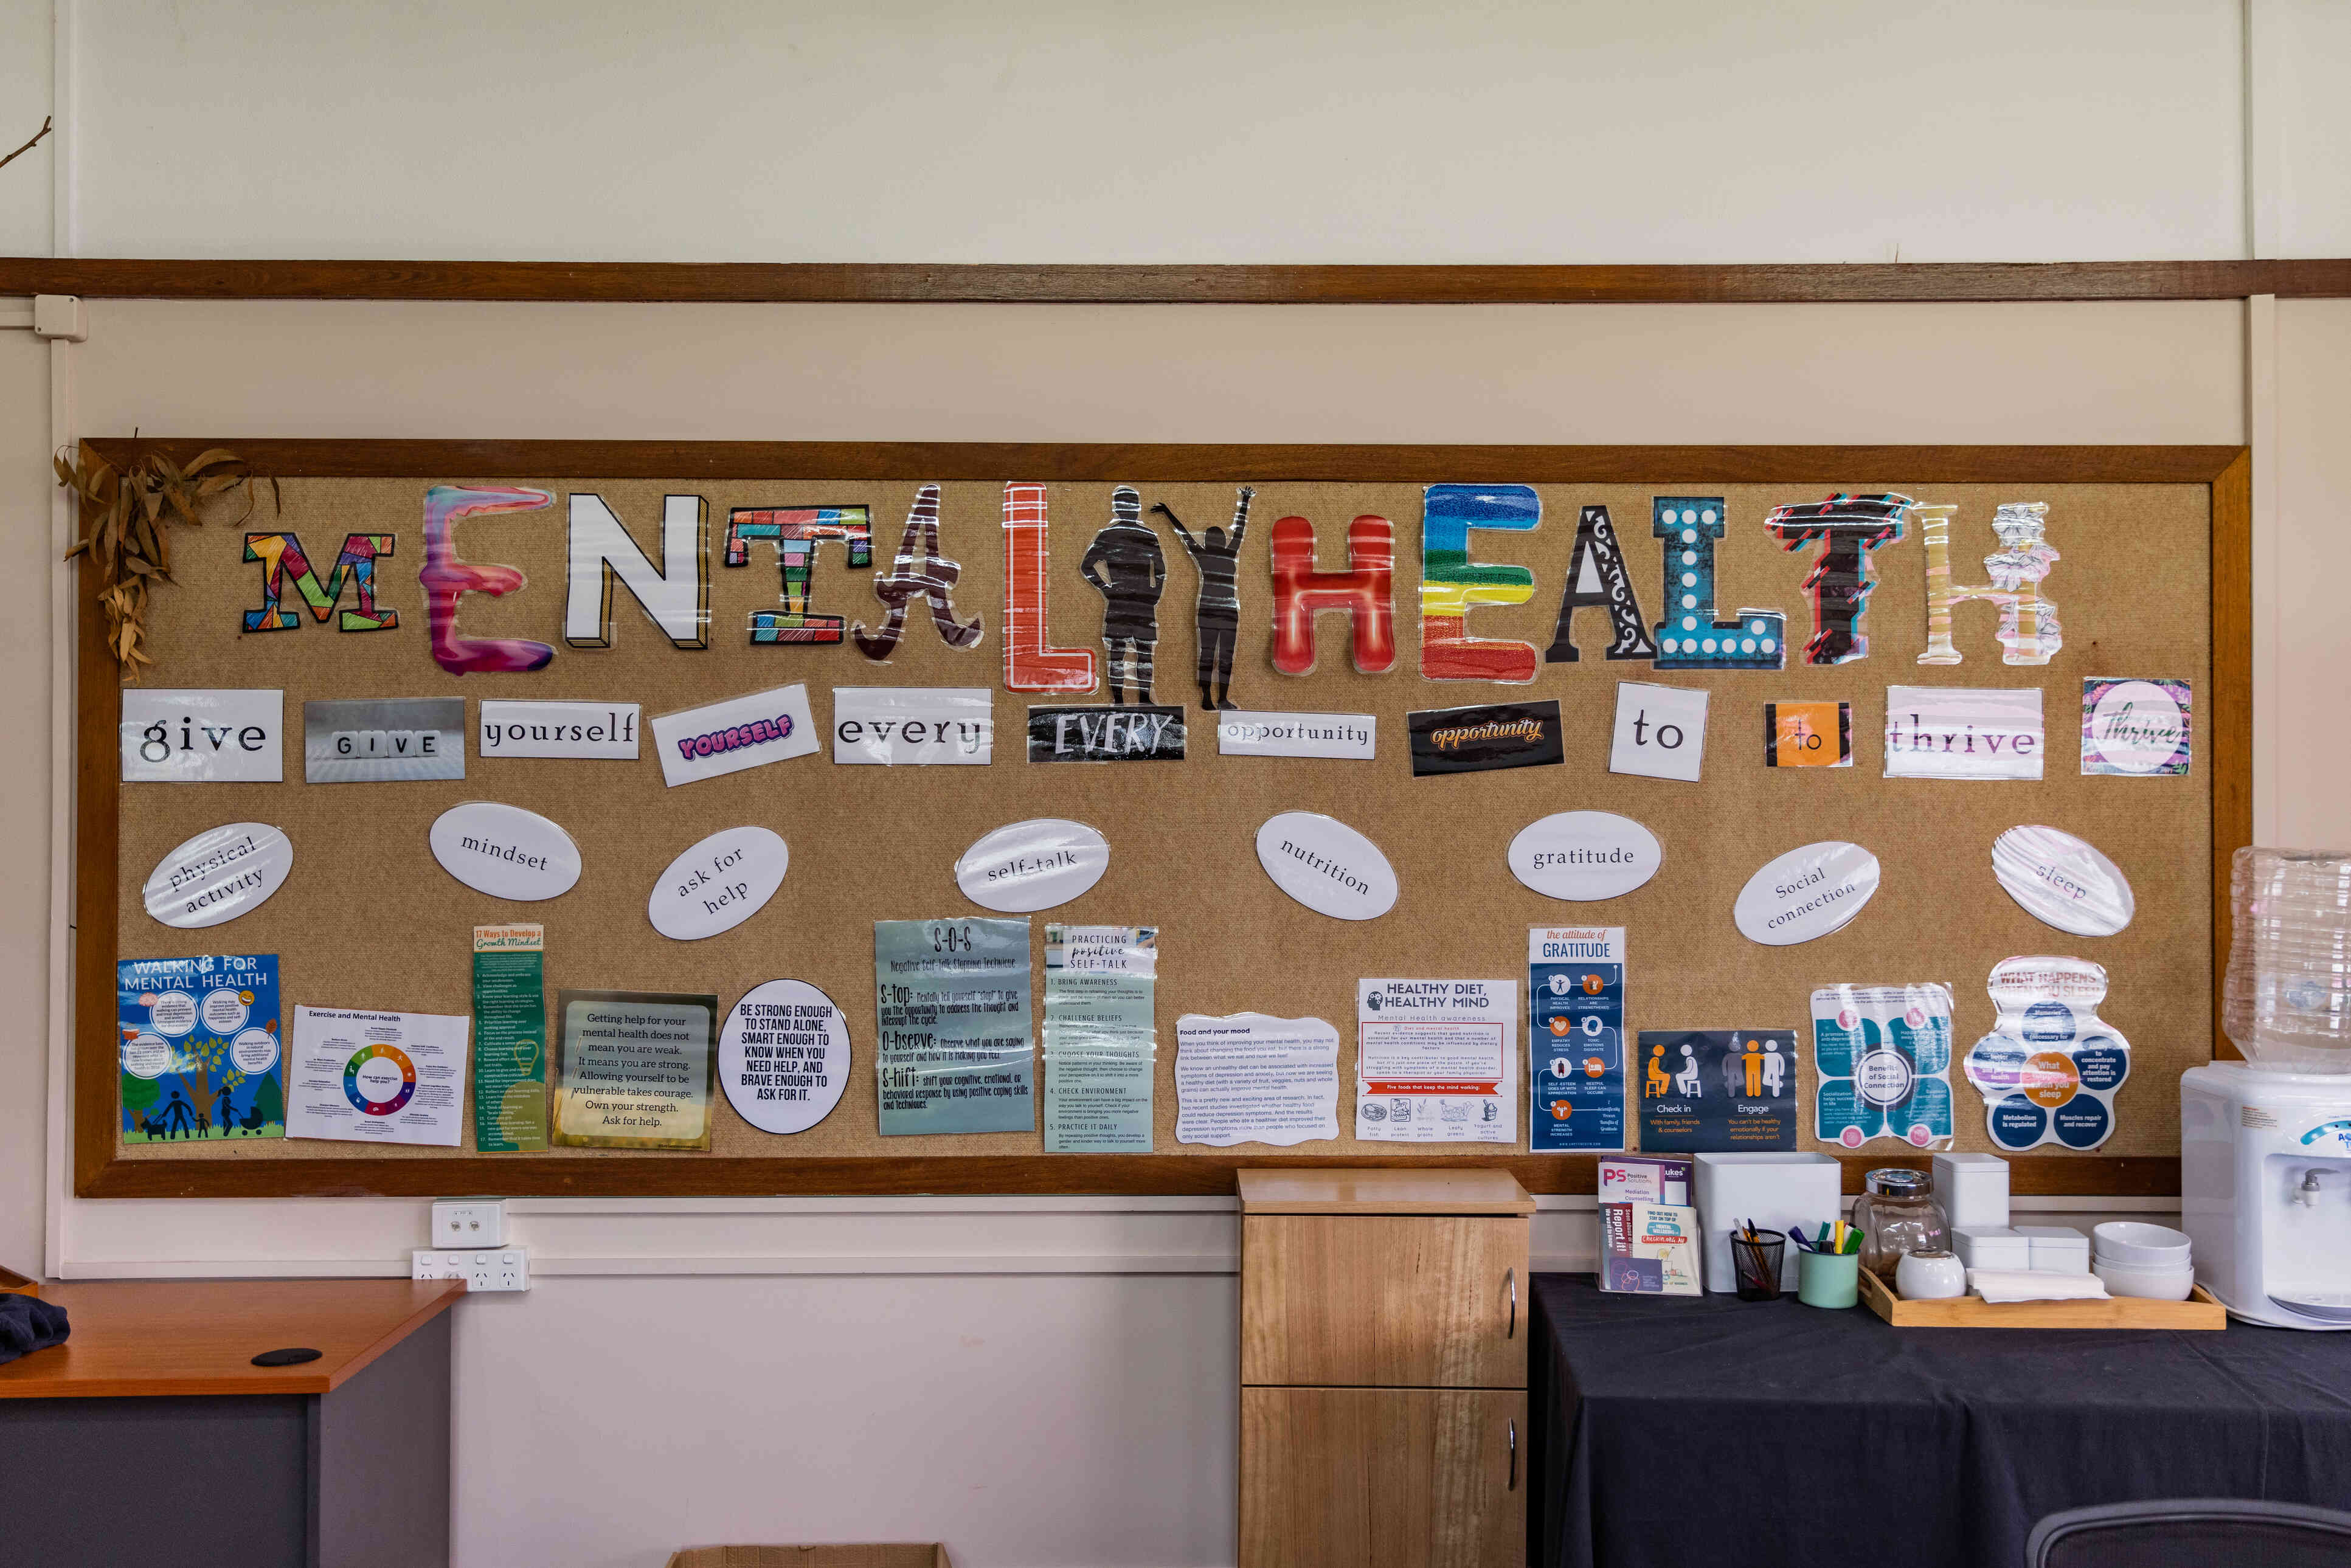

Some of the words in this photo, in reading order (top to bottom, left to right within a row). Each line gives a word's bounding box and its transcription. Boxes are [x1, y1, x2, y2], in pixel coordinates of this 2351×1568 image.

[243, 482, 1098, 692] MENTAL
[485, 713, 634, 746] yourself
[678, 714, 794, 761] YOURSELF
[838, 718, 982, 754] every
[1054, 713, 1174, 755] EVERY
[1227, 721, 1368, 746] opportunity
[1432, 718, 1544, 750] opportunity
[1635, 708, 1683, 749] to
[1795, 718, 1822, 751] to
[1893, 714, 2035, 755] thrive
[139, 717, 266, 763] give
[338, 736, 437, 755] GIVE
[461, 834, 549, 873] mindset
[1532, 848, 1635, 869] gratitude
[169, 835, 258, 893] physical
[676, 869, 712, 900] ask
[715, 846, 746, 876] for
[988, 850, 1077, 882] self-talk
[1280, 839, 1369, 896] nutrition
[185, 866, 266, 914] activity
[1775, 866, 1826, 901] Social
[2035, 864, 2088, 901] sleep
[704, 879, 750, 917] help
[1767, 881, 1856, 931] connection
[477, 938, 505, 949] Growth
[508, 938, 541, 946] Mindset
[483, 930, 500, 939] Ways
[934, 927, 971, 952] S-O-S
[1547, 930, 1559, 939] the
[1562, 930, 1596, 939] attitude
[1598, 929, 1607, 941] of
[1072, 945, 1124, 958] positive
[1543, 943, 1610, 957] GRATITUDE
[134, 958, 214, 974] WALKING
[224, 958, 257, 971] FOR
[125, 976, 193, 990] MENTAL
[203, 973, 266, 987] HEALTH
[1387, 984, 1449, 994] HEALTHY
[1455, 984, 1486, 996] DIET,
[881, 984, 912, 1007] S-top:
[1385, 997, 1447, 1007] HEALTHY
[1453, 997, 1489, 1008] MIND
[587, 1014, 622, 1024] Getting
[625, 1015, 645, 1025] help
[647, 1016, 661, 1024] for
[741, 1004, 752, 1015] BE
[755, 1005, 792, 1017] STRONG
[795, 1006, 832, 1017] ENOUGH
[618, 1029, 648, 1038] health
[745, 1018, 757, 1029] TO
[760, 1019, 790, 1031] STAND
[793, 1020, 826, 1032] ALONE,
[742, 1032, 774, 1044] SMART
[778, 1034, 814, 1045] ENOUGH
[817, 1034, 828, 1045] TO
[617, 1045, 634, 1054] you
[655, 1046, 682, 1054] weak.
[745, 1046, 773, 1058] KNOW
[776, 1047, 803, 1059] WHEN
[807, 1048, 825, 1059] YOU
[622, 1060, 639, 1068] you
[659, 1061, 690, 1071] strong.
[747, 1060, 770, 1072] NEED
[774, 1061, 800, 1074] HELP,
[803, 1062, 822, 1072] AND
[580, 1071, 623, 1082] Allowing
[626, 1073, 665, 1082] yourself
[742, 1074, 772, 1085] BRAVE
[775, 1075, 812, 1086] ENOUGH
[815, 1076, 827, 1087] TO
[883, 1066, 919, 1087] S-hift:
[574, 1086, 625, 1095] vulnerable
[628, 1088, 651, 1096] takes
[654, 1089, 693, 1099] courage.
[757, 1088, 776, 1100] ASK
[779, 1089, 796, 1100] FOR
[799, 1090, 810, 1100] IT.
[586, 1100, 609, 1109] Own
[612, 1102, 634, 1111] your
[637, 1103, 678, 1113] strength.
[1738, 1105, 1768, 1114] Engage
[639, 1117, 662, 1127] help.
[1604, 1169, 1626, 1186] PS
[1613, 1209, 1625, 1241] Report
[1617, 1242, 1627, 1251] it!
